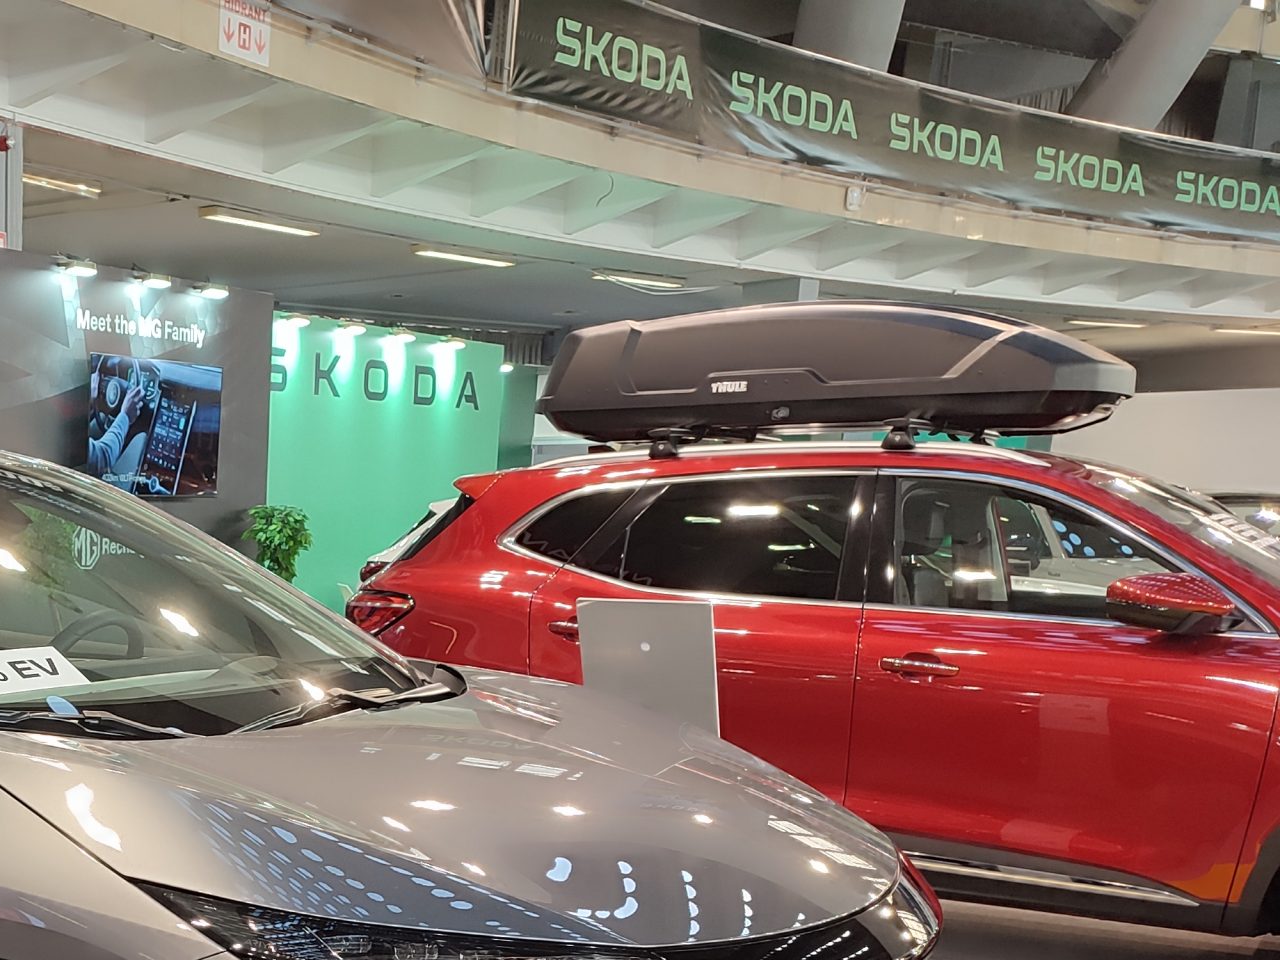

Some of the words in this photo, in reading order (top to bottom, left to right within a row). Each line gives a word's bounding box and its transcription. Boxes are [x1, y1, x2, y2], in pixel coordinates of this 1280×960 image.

[76, 308, 112, 332] Meet
[115, 314, 137, 336] the
[164, 320, 206, 349] Family
[711, 381, 748, 393] THULE
[73, 526, 100, 569] MG
[7, 658, 60, 679] EV
